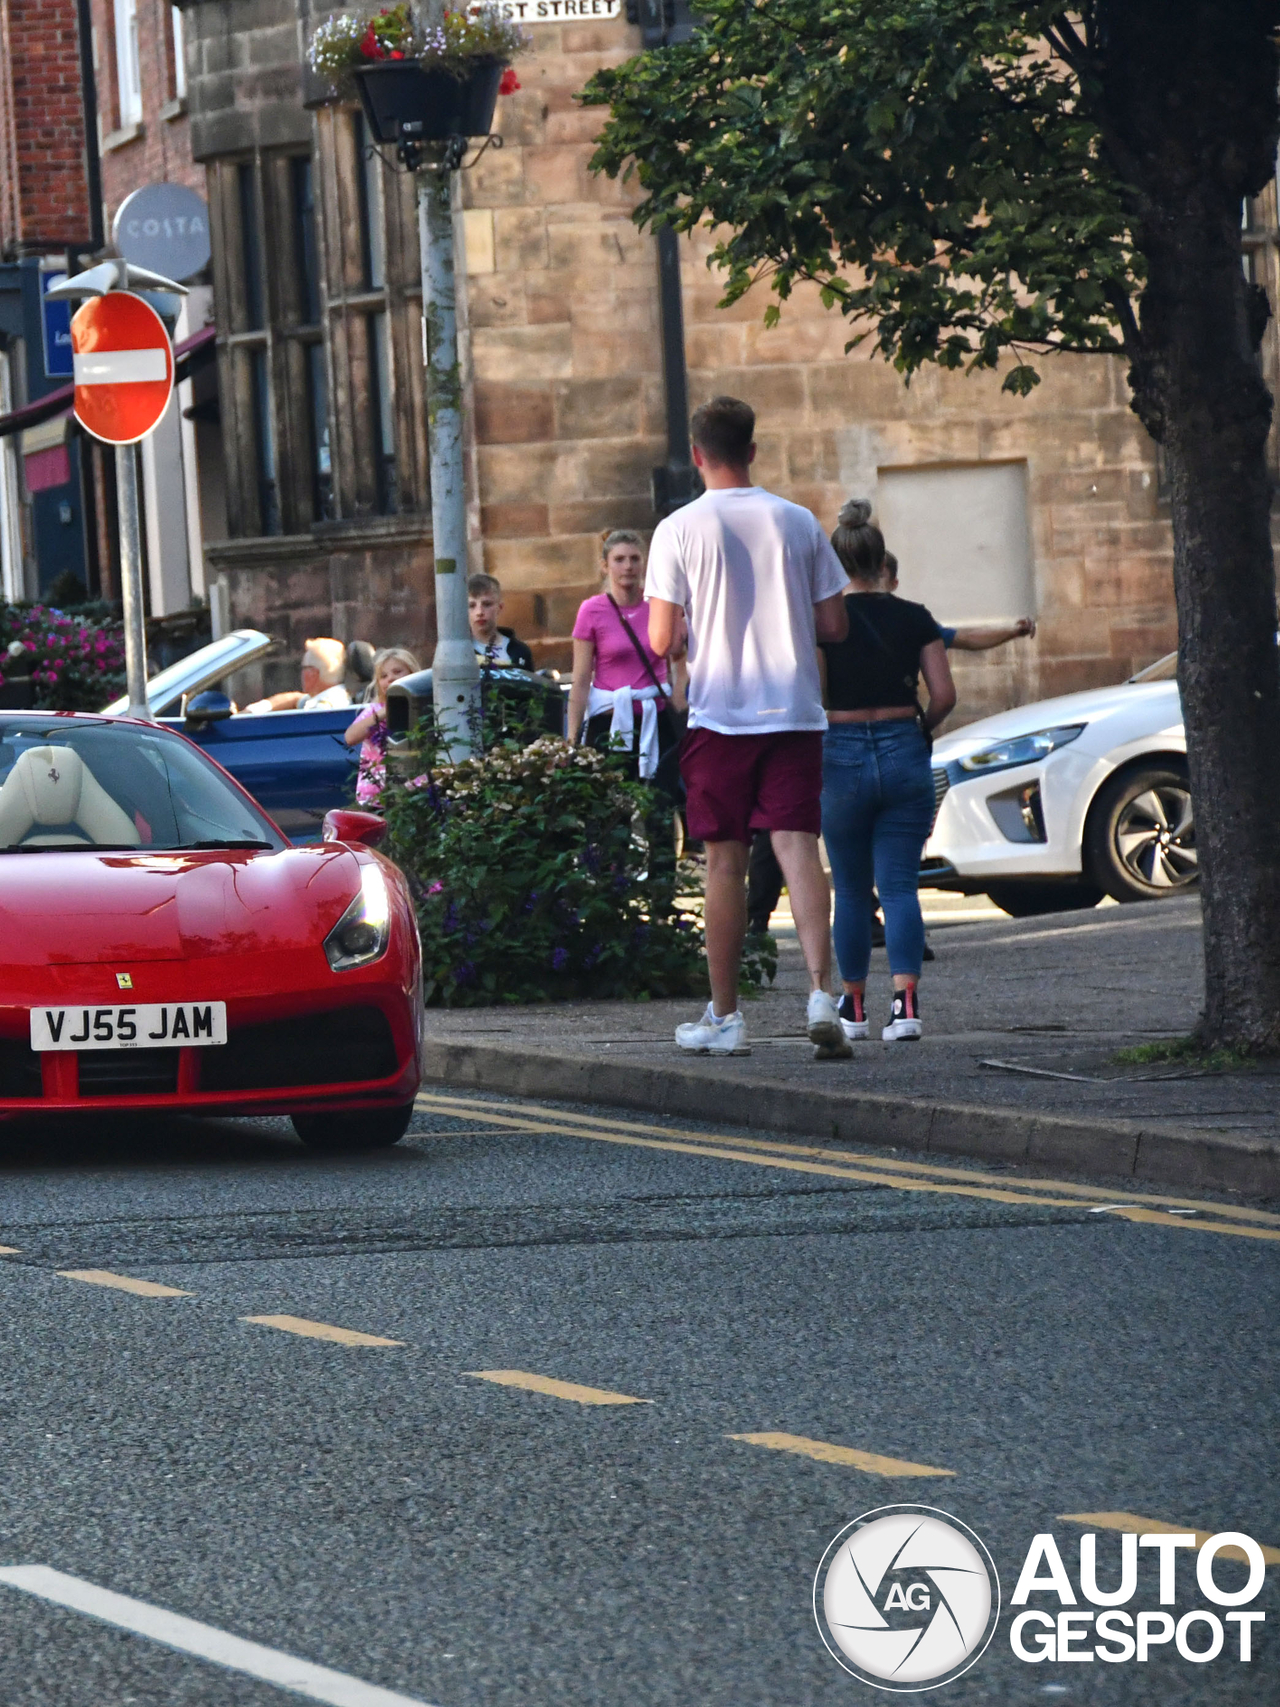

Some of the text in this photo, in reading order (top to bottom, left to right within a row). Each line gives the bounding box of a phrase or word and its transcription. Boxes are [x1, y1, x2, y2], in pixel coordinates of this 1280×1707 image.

[537, 0, 617, 17] STREET
[126, 217, 204, 238] COSTA
[45, 1006, 213, 1043] VJ55 JAM
